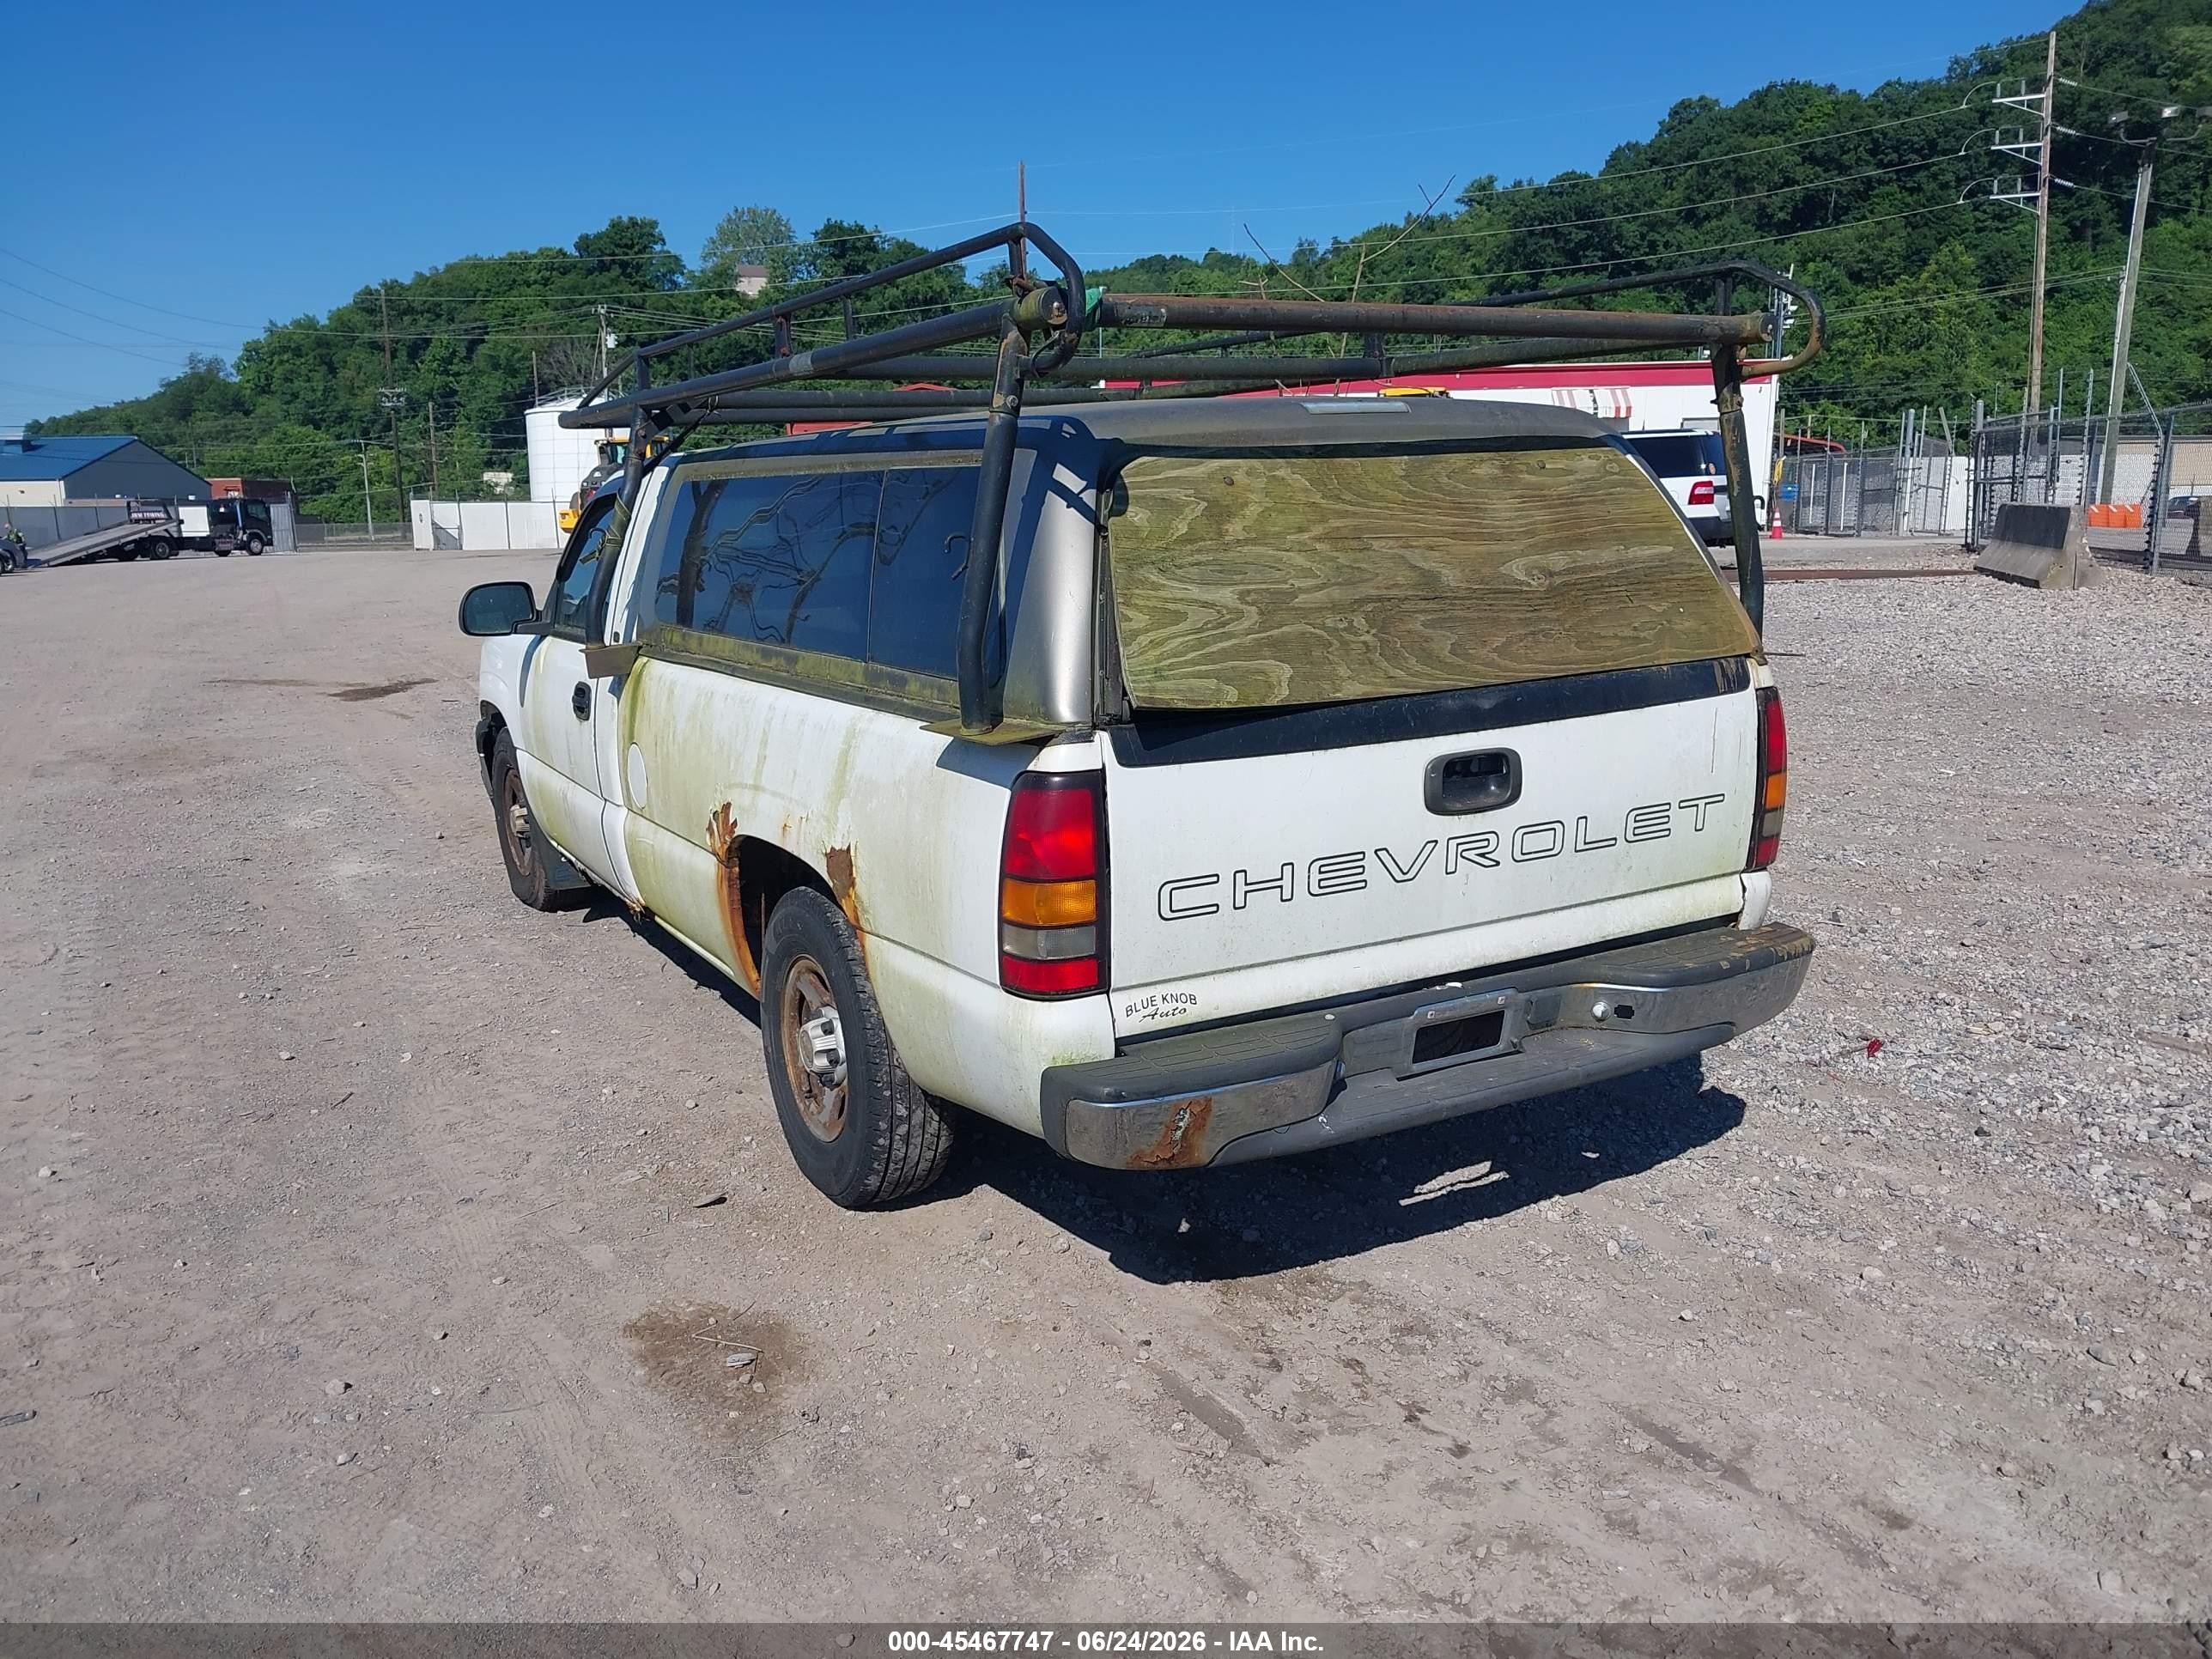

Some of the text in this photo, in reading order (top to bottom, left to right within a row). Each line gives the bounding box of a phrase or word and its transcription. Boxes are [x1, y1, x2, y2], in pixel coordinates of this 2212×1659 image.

[1158, 793, 1725, 921] CHEVROLET
[1125, 993, 1197, 1018] BLUE KNOB
[1139, 1007, 1187, 1023] Auto
